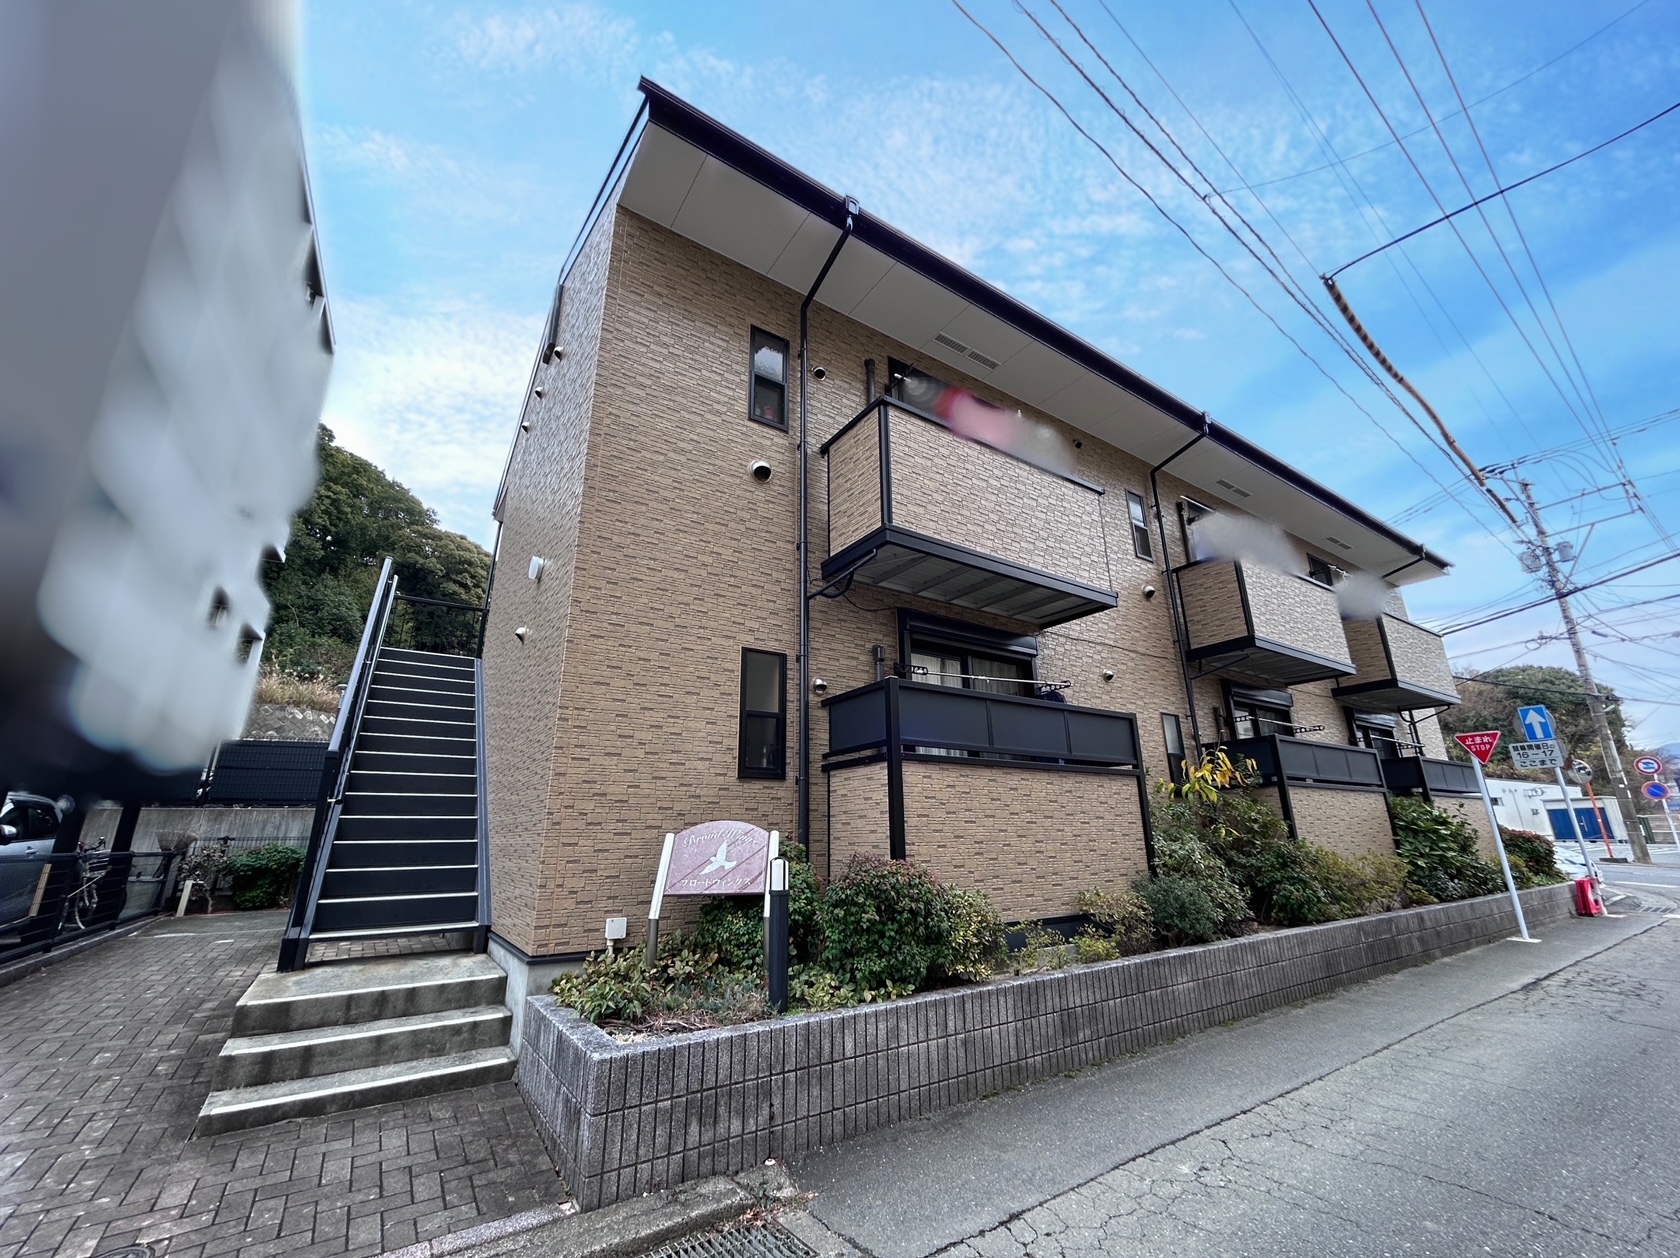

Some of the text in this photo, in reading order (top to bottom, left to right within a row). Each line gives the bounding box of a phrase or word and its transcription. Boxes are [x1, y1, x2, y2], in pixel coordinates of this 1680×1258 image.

[1465, 735, 1492, 744] 止まれ
[1520, 759, 1557, 767] ここまで
